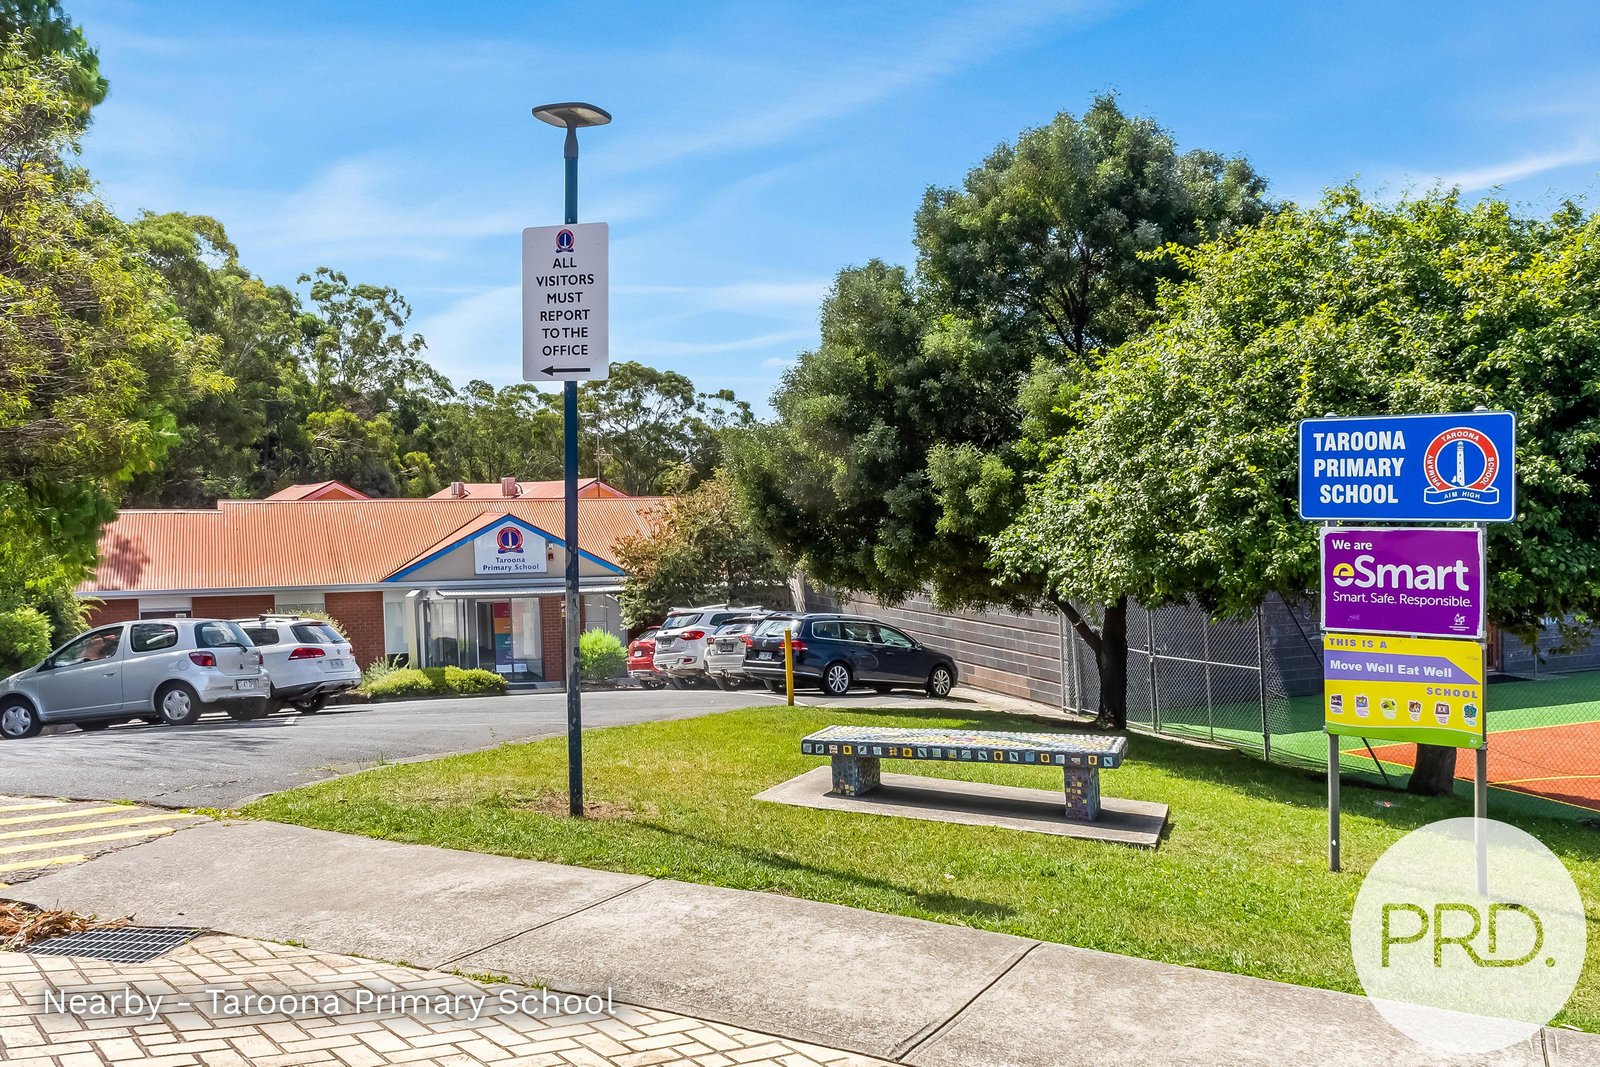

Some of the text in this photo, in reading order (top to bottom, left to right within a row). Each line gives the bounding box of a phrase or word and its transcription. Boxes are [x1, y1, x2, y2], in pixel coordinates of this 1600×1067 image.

[552, 257, 577, 269] ALL
[536, 273, 595, 287] VISITORS
[546, 292, 584, 304] MUST
[540, 309, 591, 322] REPORT
[542, 327, 589, 339] TO THE
[542, 344, 589, 357] OFFICE
[1313, 430, 1406, 452] TAROONA
[1441, 431, 1480, 442] TAROONA
[1313, 457, 1405, 478] PRIMARY
[1427, 454, 1441, 487] PRIMARY
[1480, 457, 1495, 485] SCHOOL
[1319, 484, 1399, 504] SCHOOL
[1443, 491, 1480, 500] AIM HIGH
[1332, 539, 1373, 551] We are
[483, 564, 512, 572] Primary
[1332, 554, 1470, 592] eSmart
[1333, 591, 1473, 608] Smart. Safe. Responsible.
[1329, 638, 1388, 649] THIS IS A
[1330, 659, 1452, 678] Move Well Eat Well
[1426, 687, 1479, 699] SCHOOL
